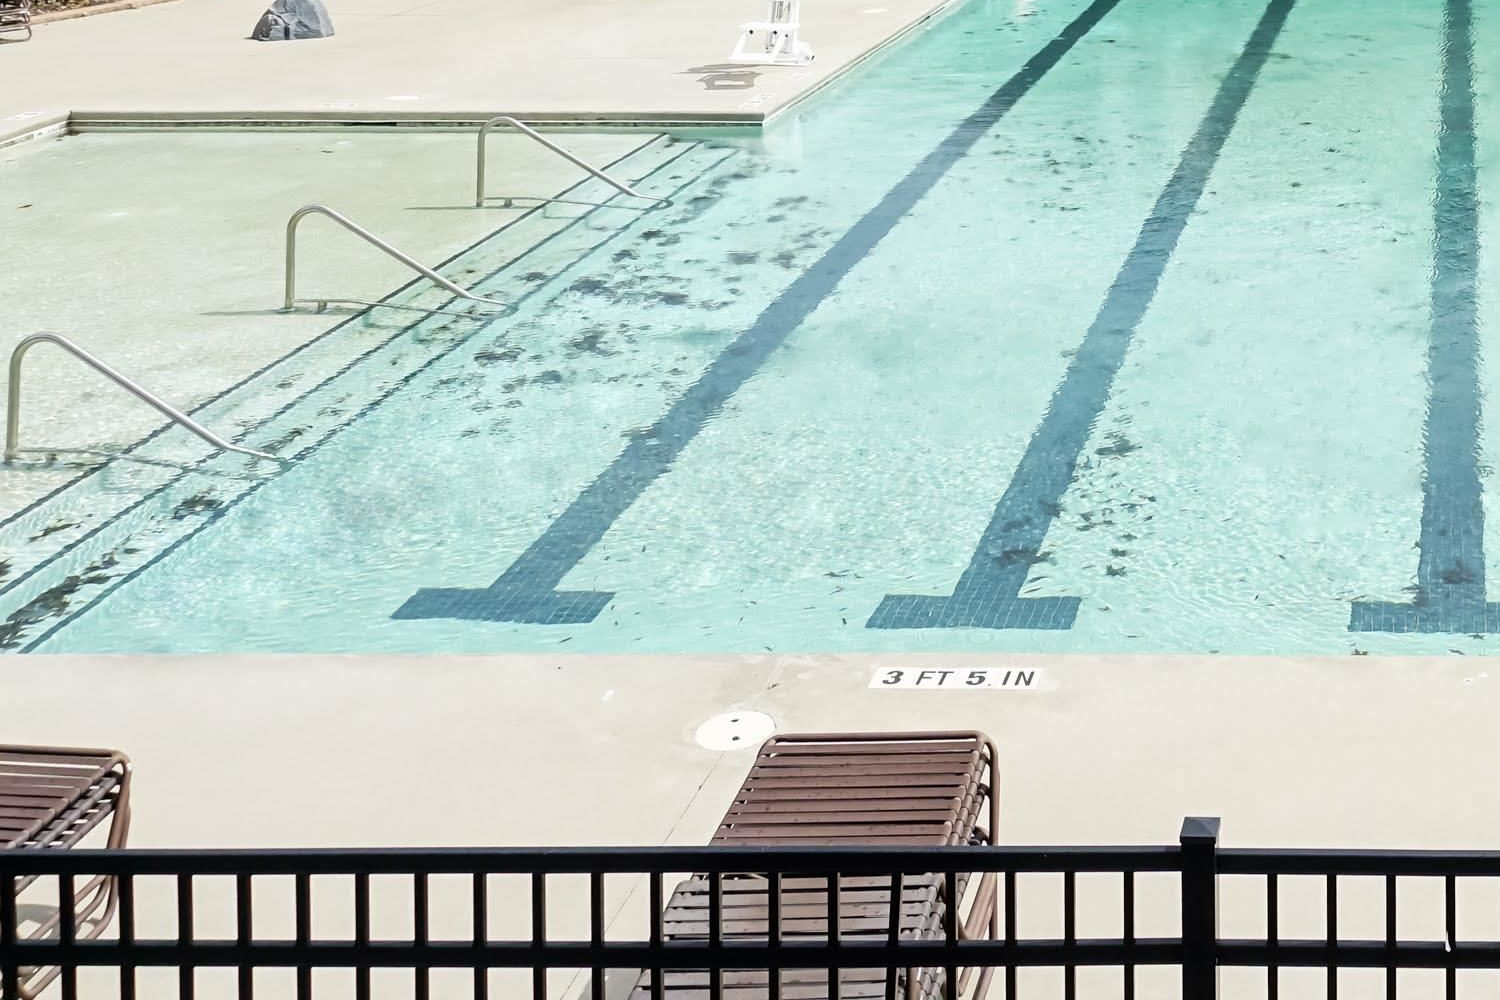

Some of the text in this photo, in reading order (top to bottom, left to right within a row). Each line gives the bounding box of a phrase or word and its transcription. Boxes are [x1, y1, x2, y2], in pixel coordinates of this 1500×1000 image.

[881, 670, 1036, 687] 3 FT 5 IN
